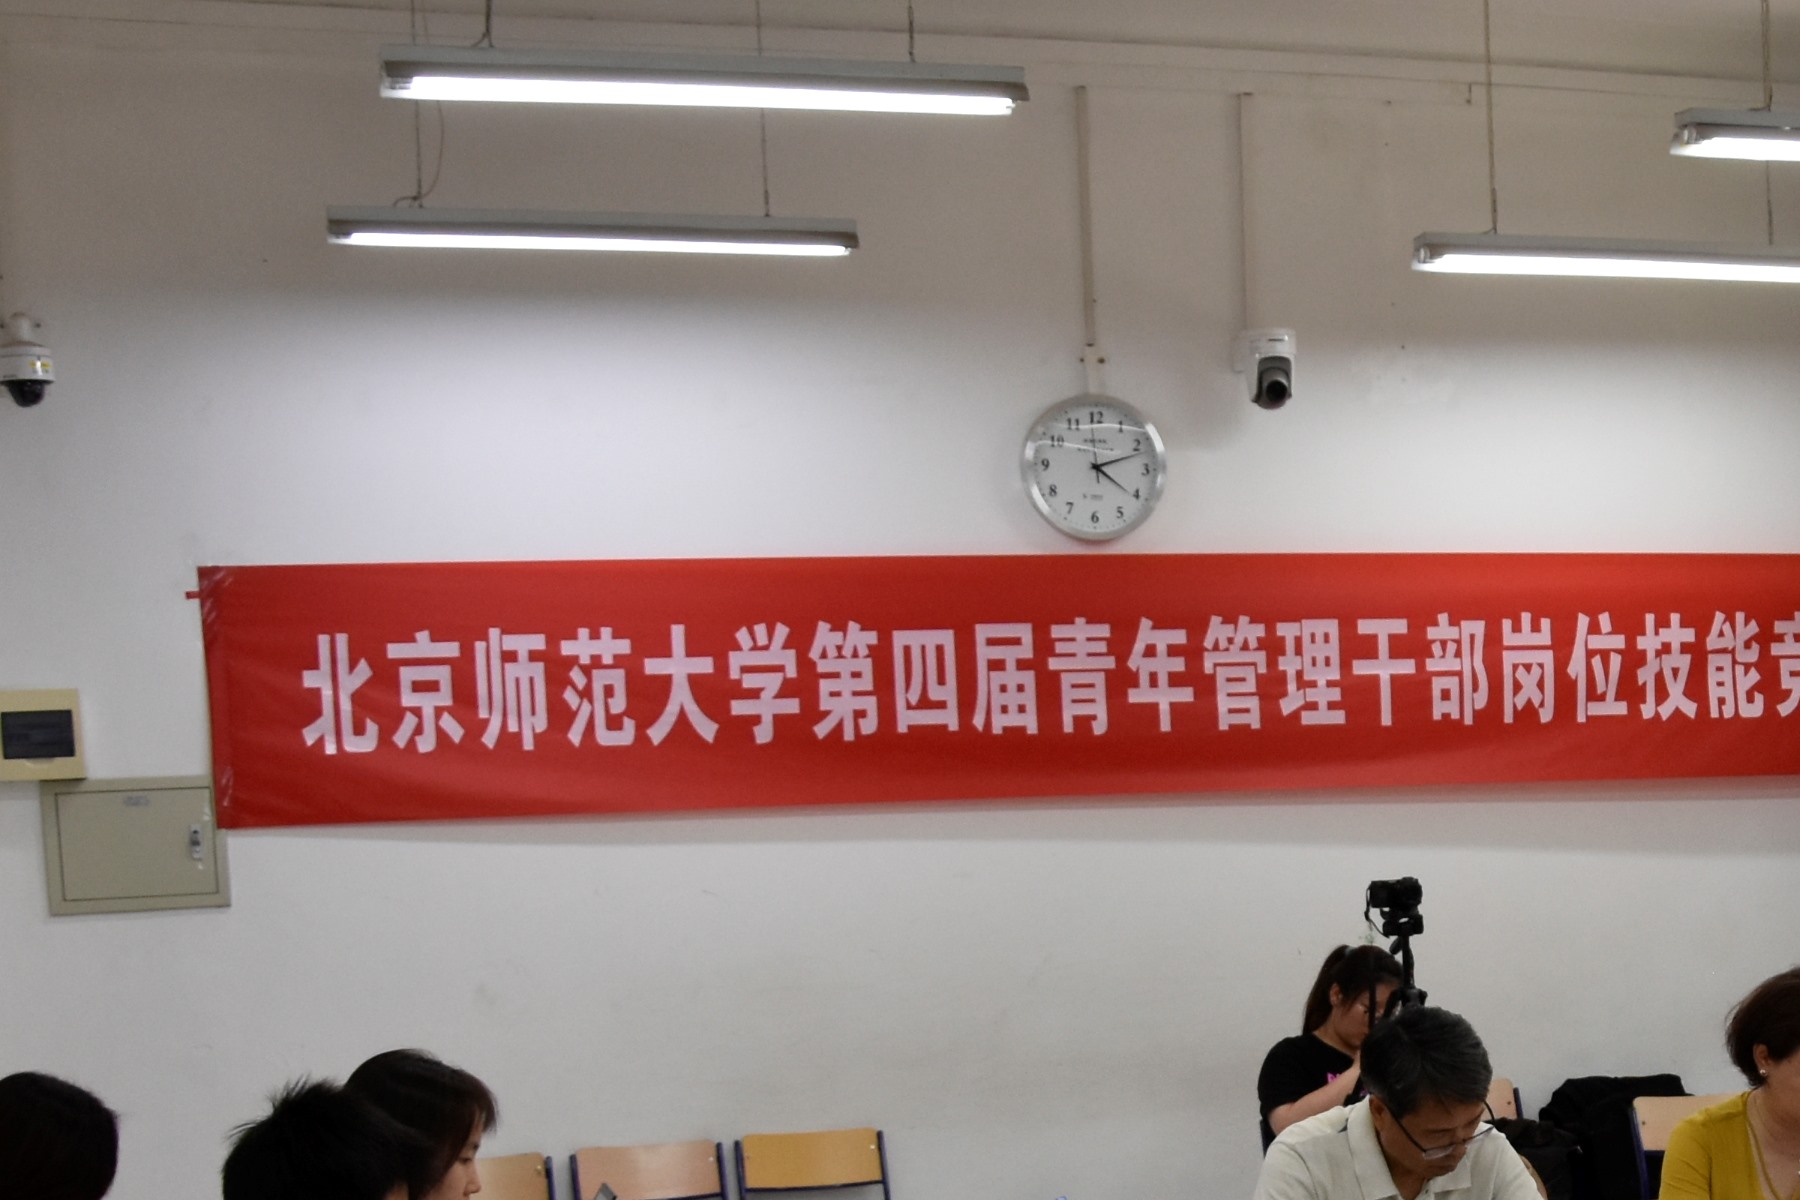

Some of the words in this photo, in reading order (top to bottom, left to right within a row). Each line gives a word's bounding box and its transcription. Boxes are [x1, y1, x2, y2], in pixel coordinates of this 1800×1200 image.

[1089, 411, 1104, 424] 12
[1066, 418, 1080, 431] 11
[1118, 420, 1124, 433] 1
[1050, 435, 1064, 448] 10
[1132, 439, 1141, 451] 2
[1041, 458, 1050, 471] 9
[1141, 463, 1150, 476] 3
[1049, 484, 1057, 497] 8
[1132, 488, 1140, 500] 4
[1065, 502, 1074, 514] 7
[1116, 506, 1124, 519] 5
[1091, 511, 1099, 523] 6
